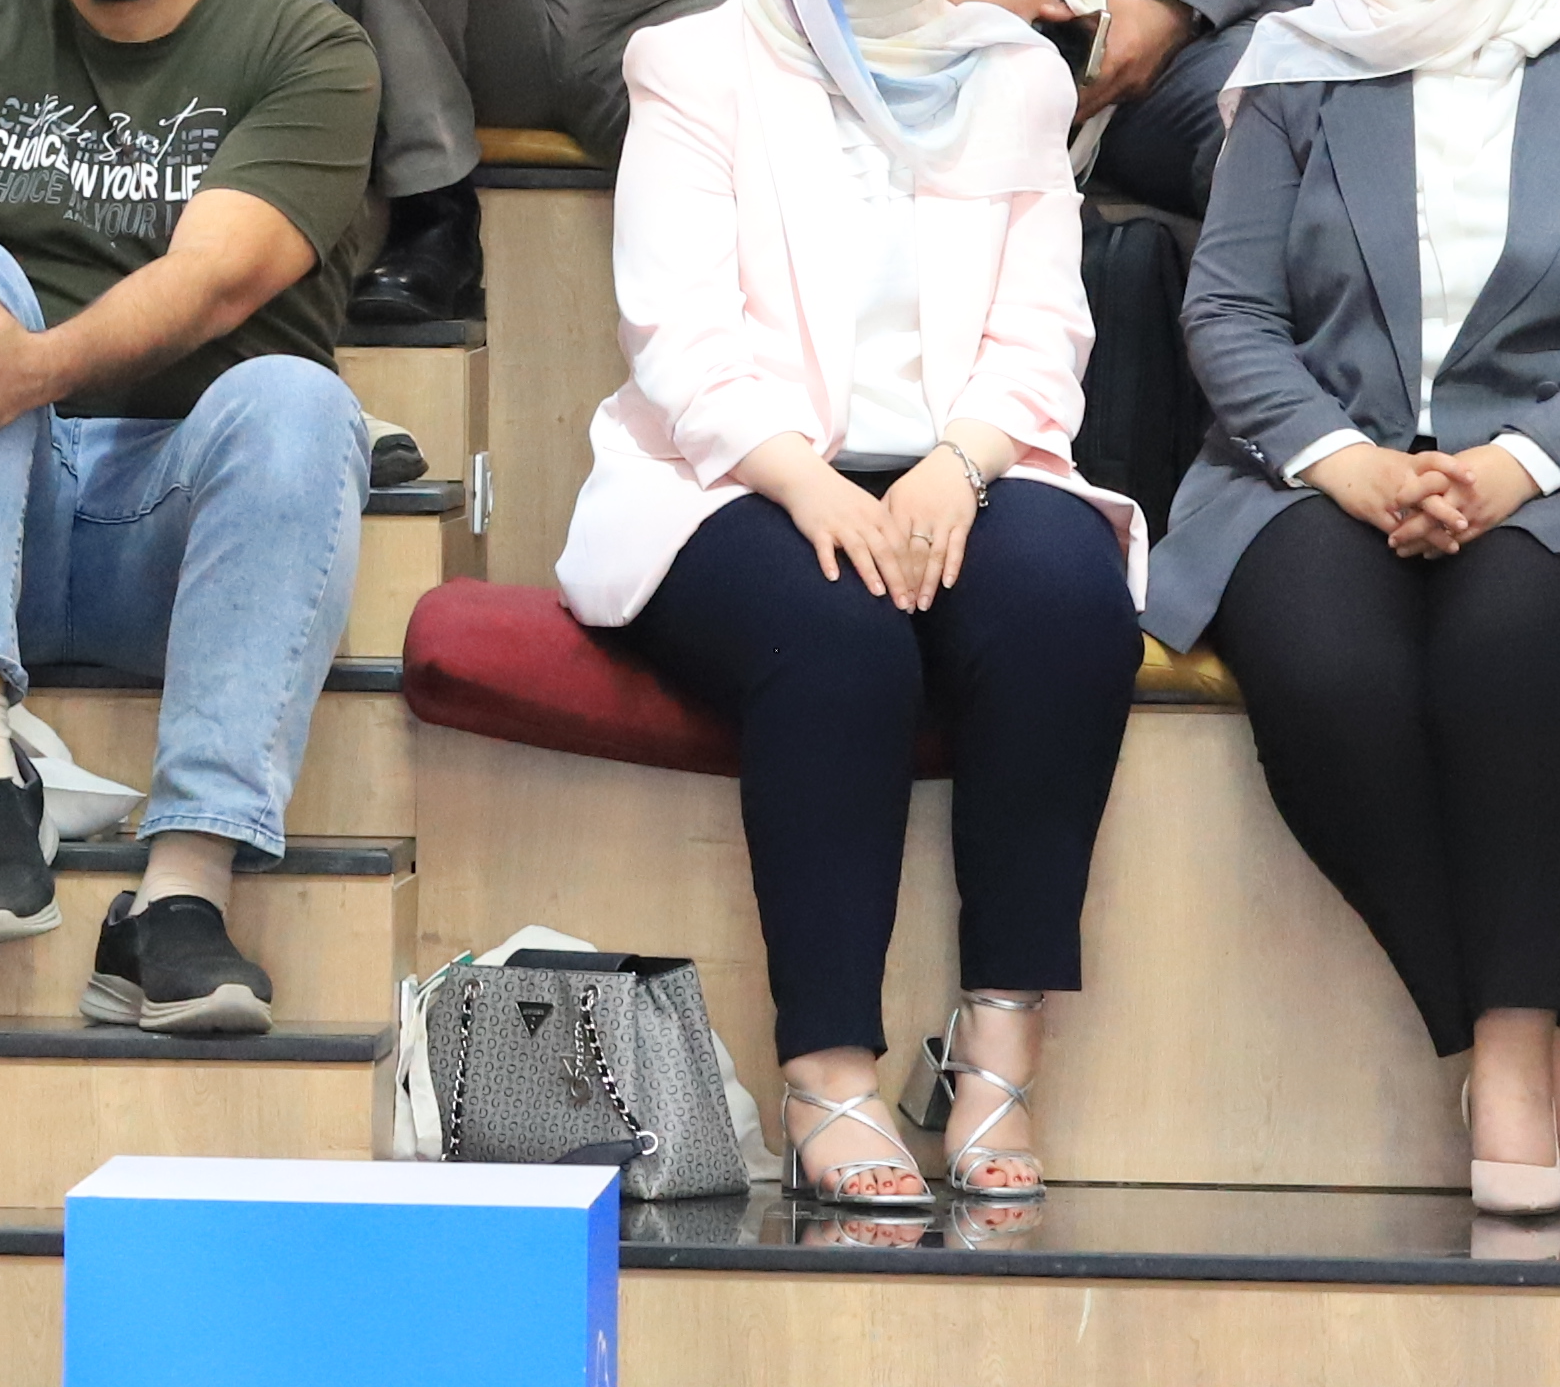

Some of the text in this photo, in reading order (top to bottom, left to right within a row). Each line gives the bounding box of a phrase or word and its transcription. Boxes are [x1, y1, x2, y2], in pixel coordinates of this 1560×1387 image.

[71, 160, 99, 199] IN
[100, 162, 159, 202] YOUR
[165, 164, 209, 202] LIF
